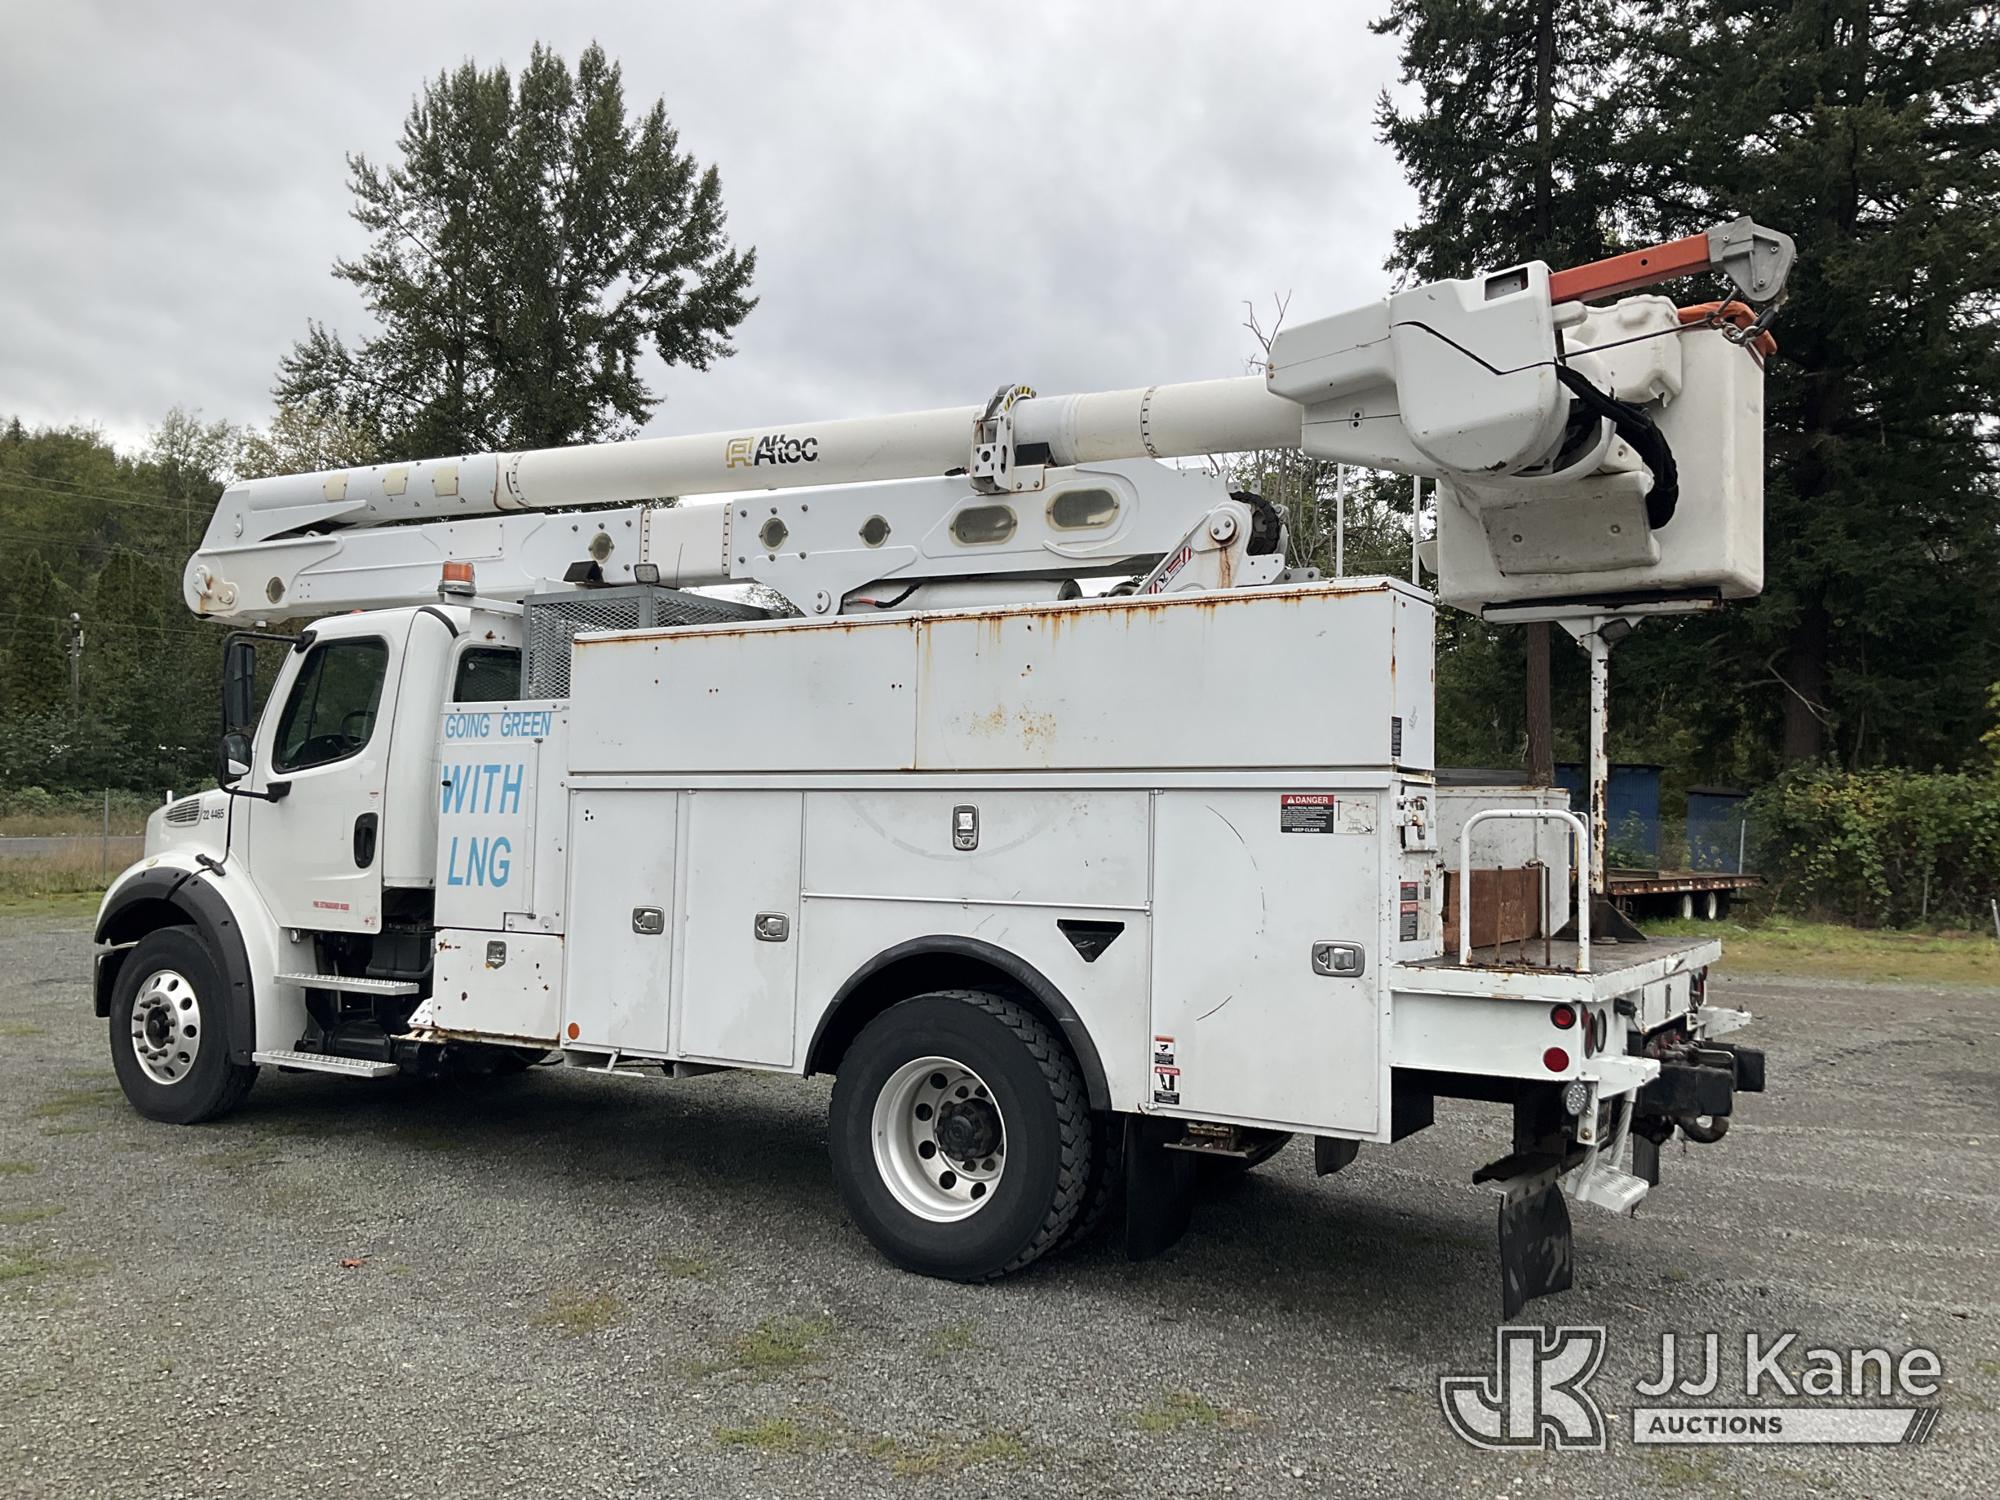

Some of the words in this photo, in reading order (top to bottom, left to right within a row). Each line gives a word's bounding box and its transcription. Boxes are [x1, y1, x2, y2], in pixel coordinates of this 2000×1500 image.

[445, 712, 491, 739] GOING
[500, 711, 552, 738] GREEN
[441, 764, 524, 814] WITH
[1295, 796, 1329, 804] DANGER
[202, 809, 210, 820] 22
[447, 836, 512, 888] LNG
